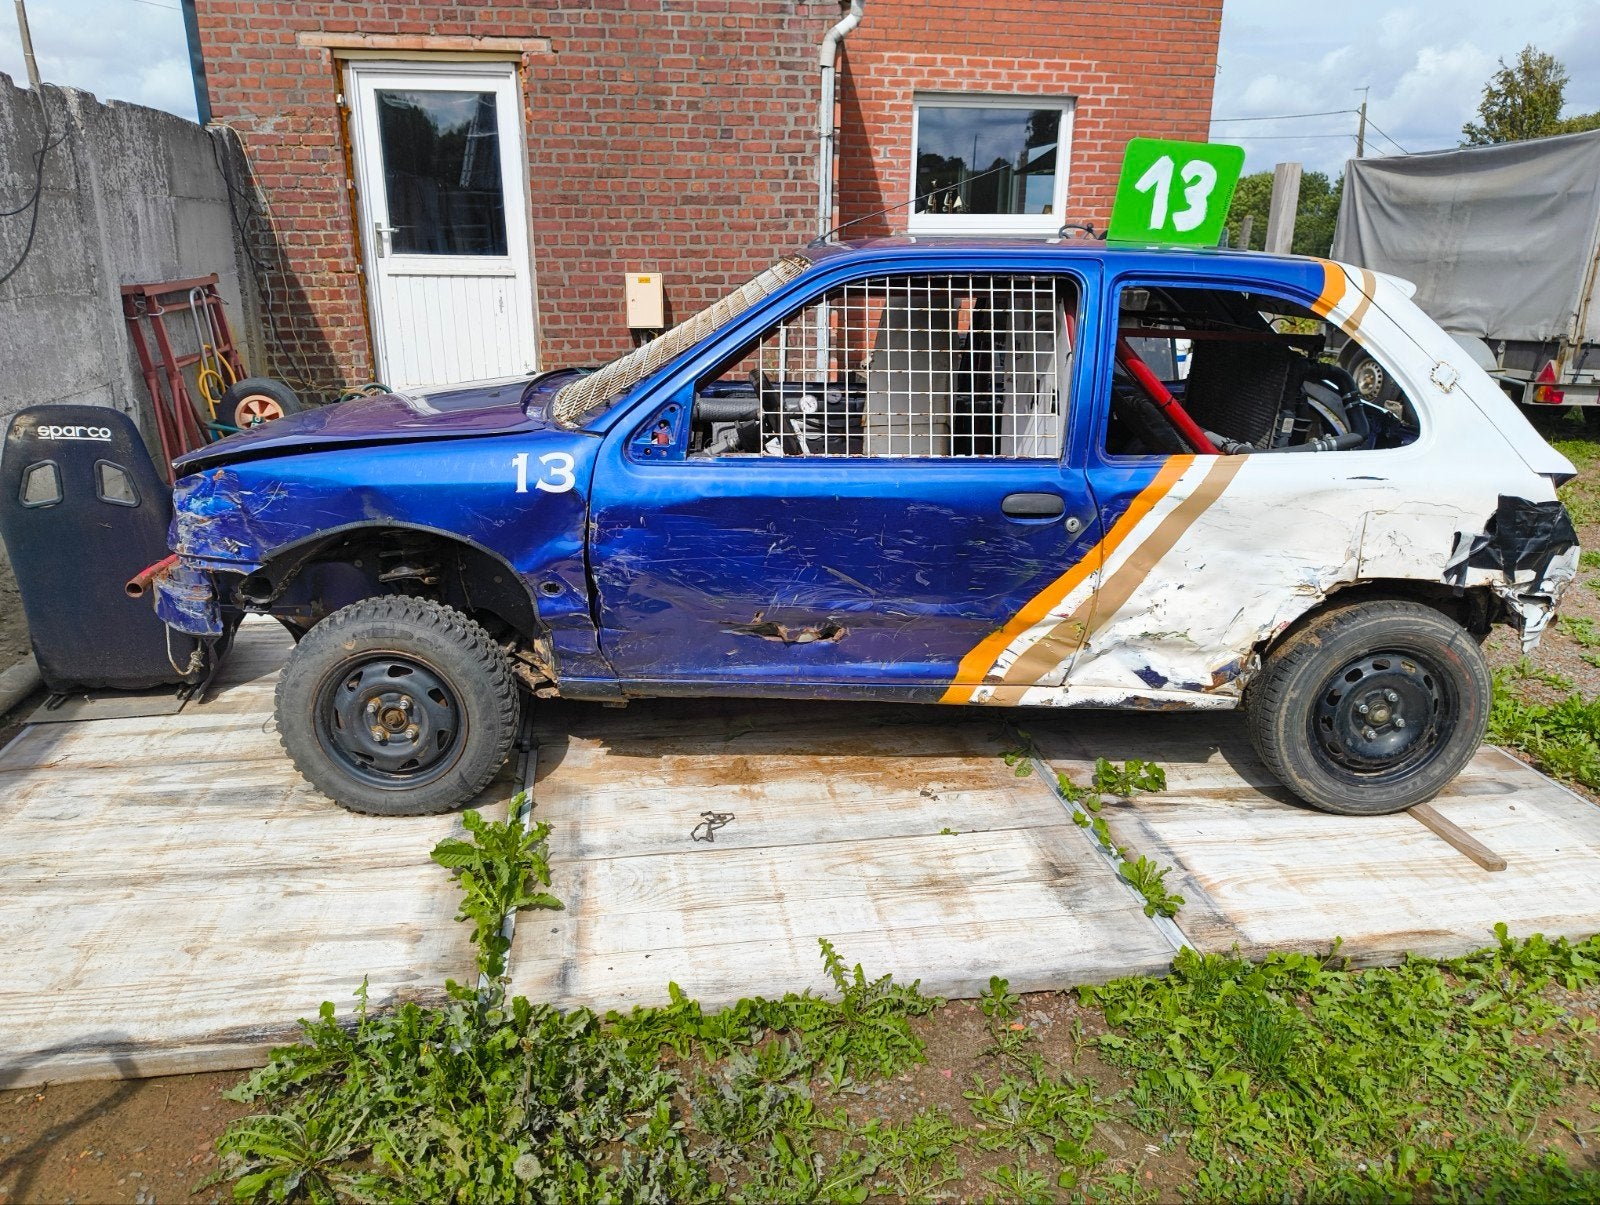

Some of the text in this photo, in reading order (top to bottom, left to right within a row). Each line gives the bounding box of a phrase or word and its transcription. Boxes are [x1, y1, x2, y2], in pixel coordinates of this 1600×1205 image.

[1134, 155, 1218, 232] 13
[37, 425, 112, 441] sparco
[511, 451, 576, 493] 13
